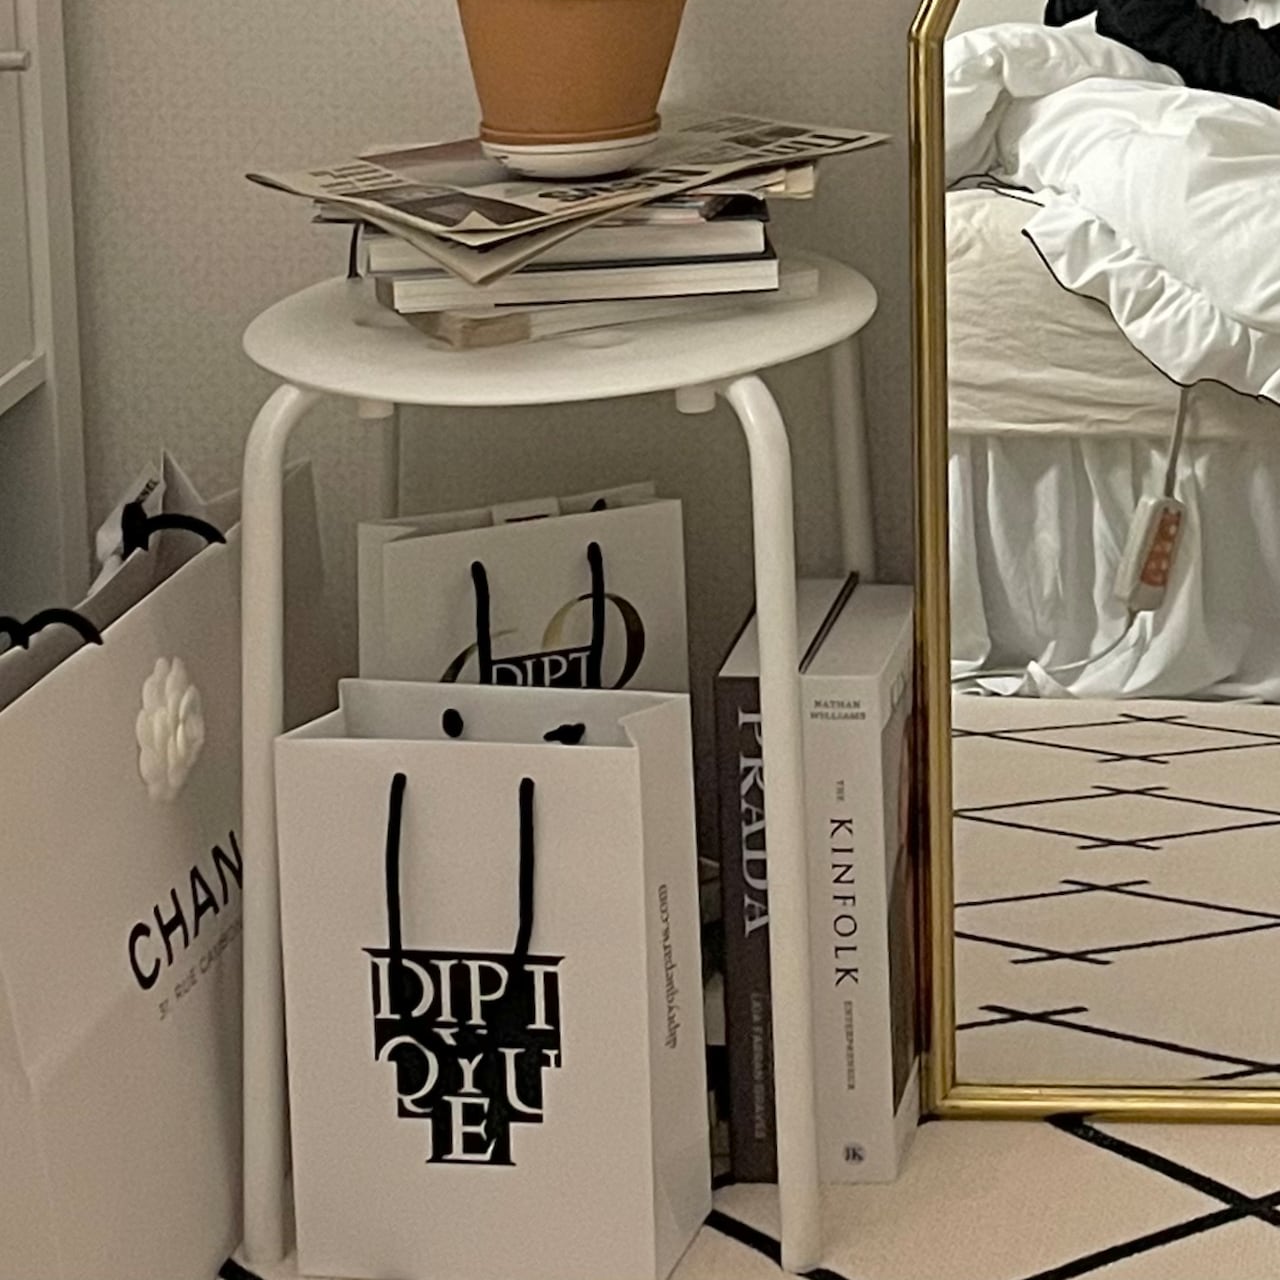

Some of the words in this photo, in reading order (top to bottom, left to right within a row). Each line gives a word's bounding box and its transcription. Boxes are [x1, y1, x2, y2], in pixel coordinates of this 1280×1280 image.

[810, 711, 867, 721] WILLIAMS
[814, 699, 861, 709] NATHAN
[738, 706, 769, 939] PRADA
[830, 816, 860, 988] KINFOLK
